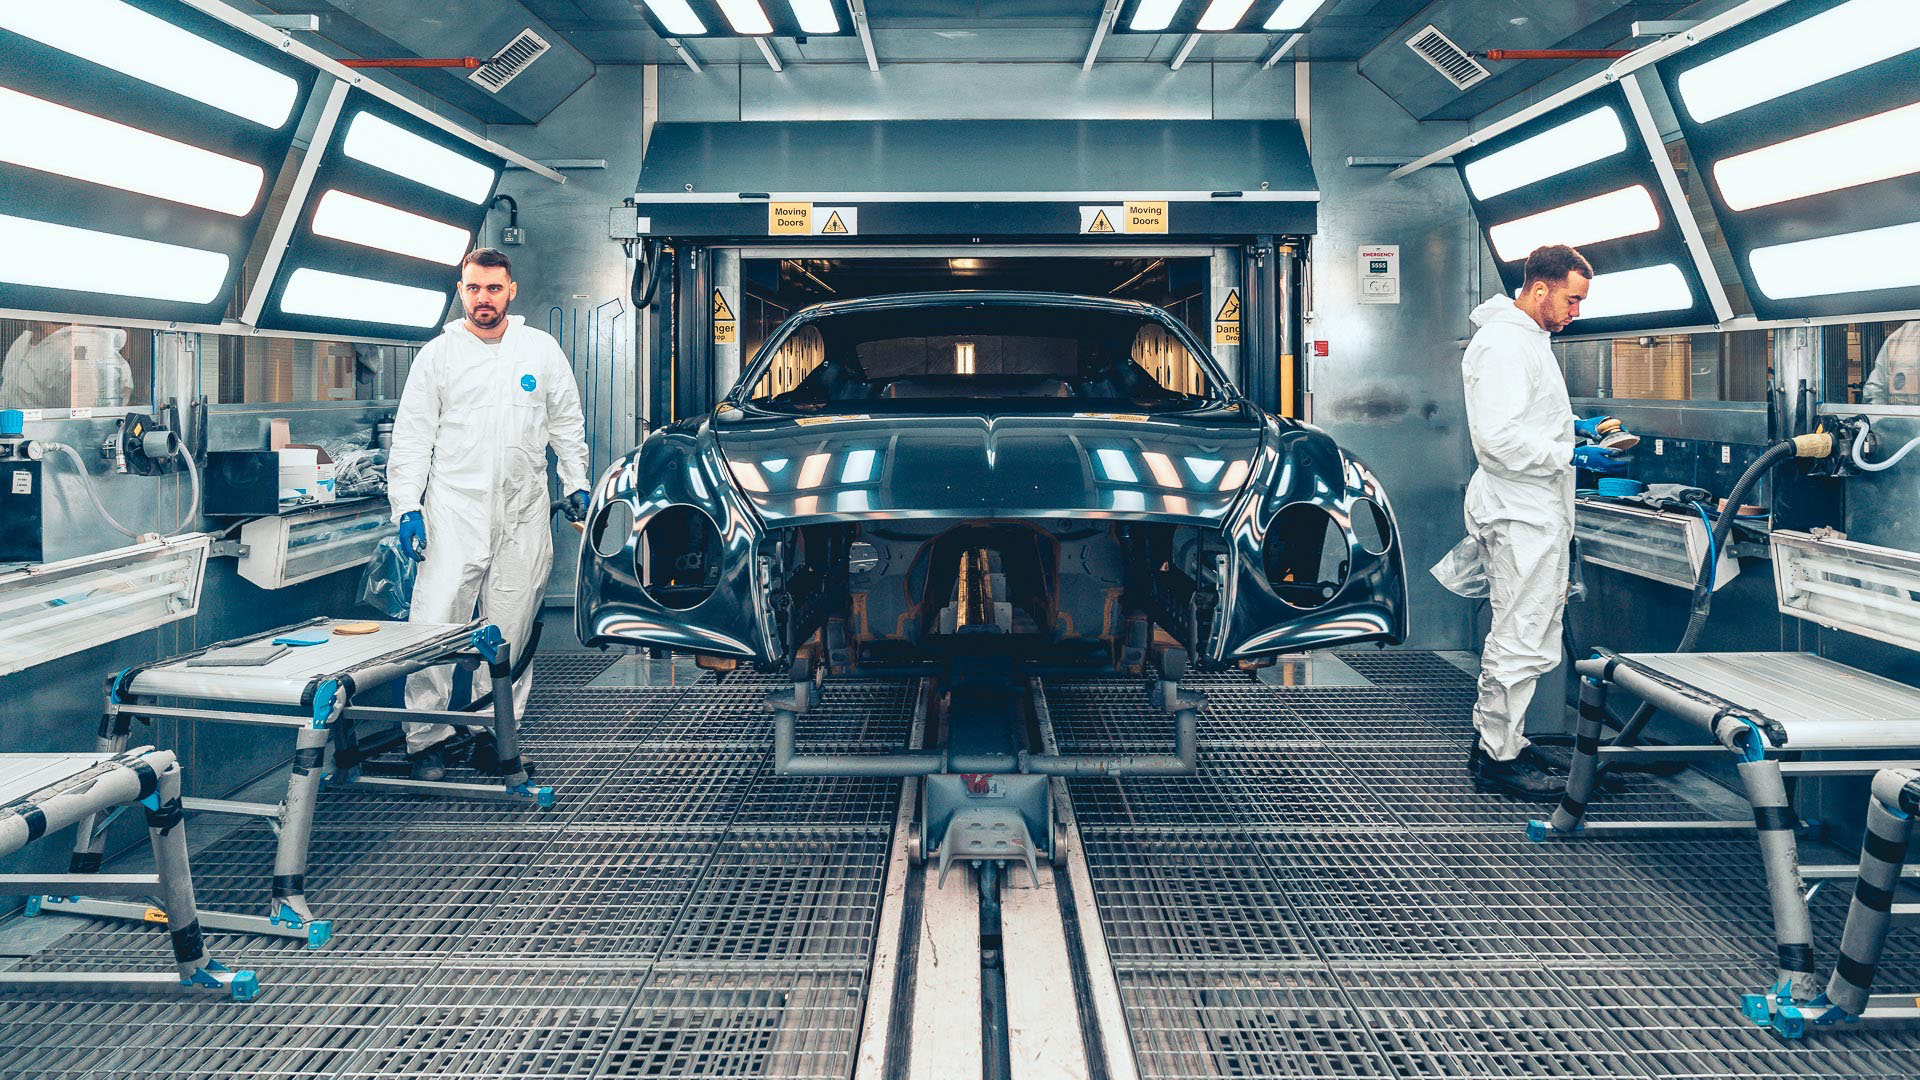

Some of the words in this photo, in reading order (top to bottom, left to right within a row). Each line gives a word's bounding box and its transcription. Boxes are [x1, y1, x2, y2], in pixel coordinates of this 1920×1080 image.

[775, 208, 807, 217] Moving
[1130, 206, 1162, 215] Moving
[777, 218, 804, 227] Doors
[1132, 217, 1159, 225] Doors
[714, 325, 735, 335] nger
[1216, 325, 1240, 335] Dang
